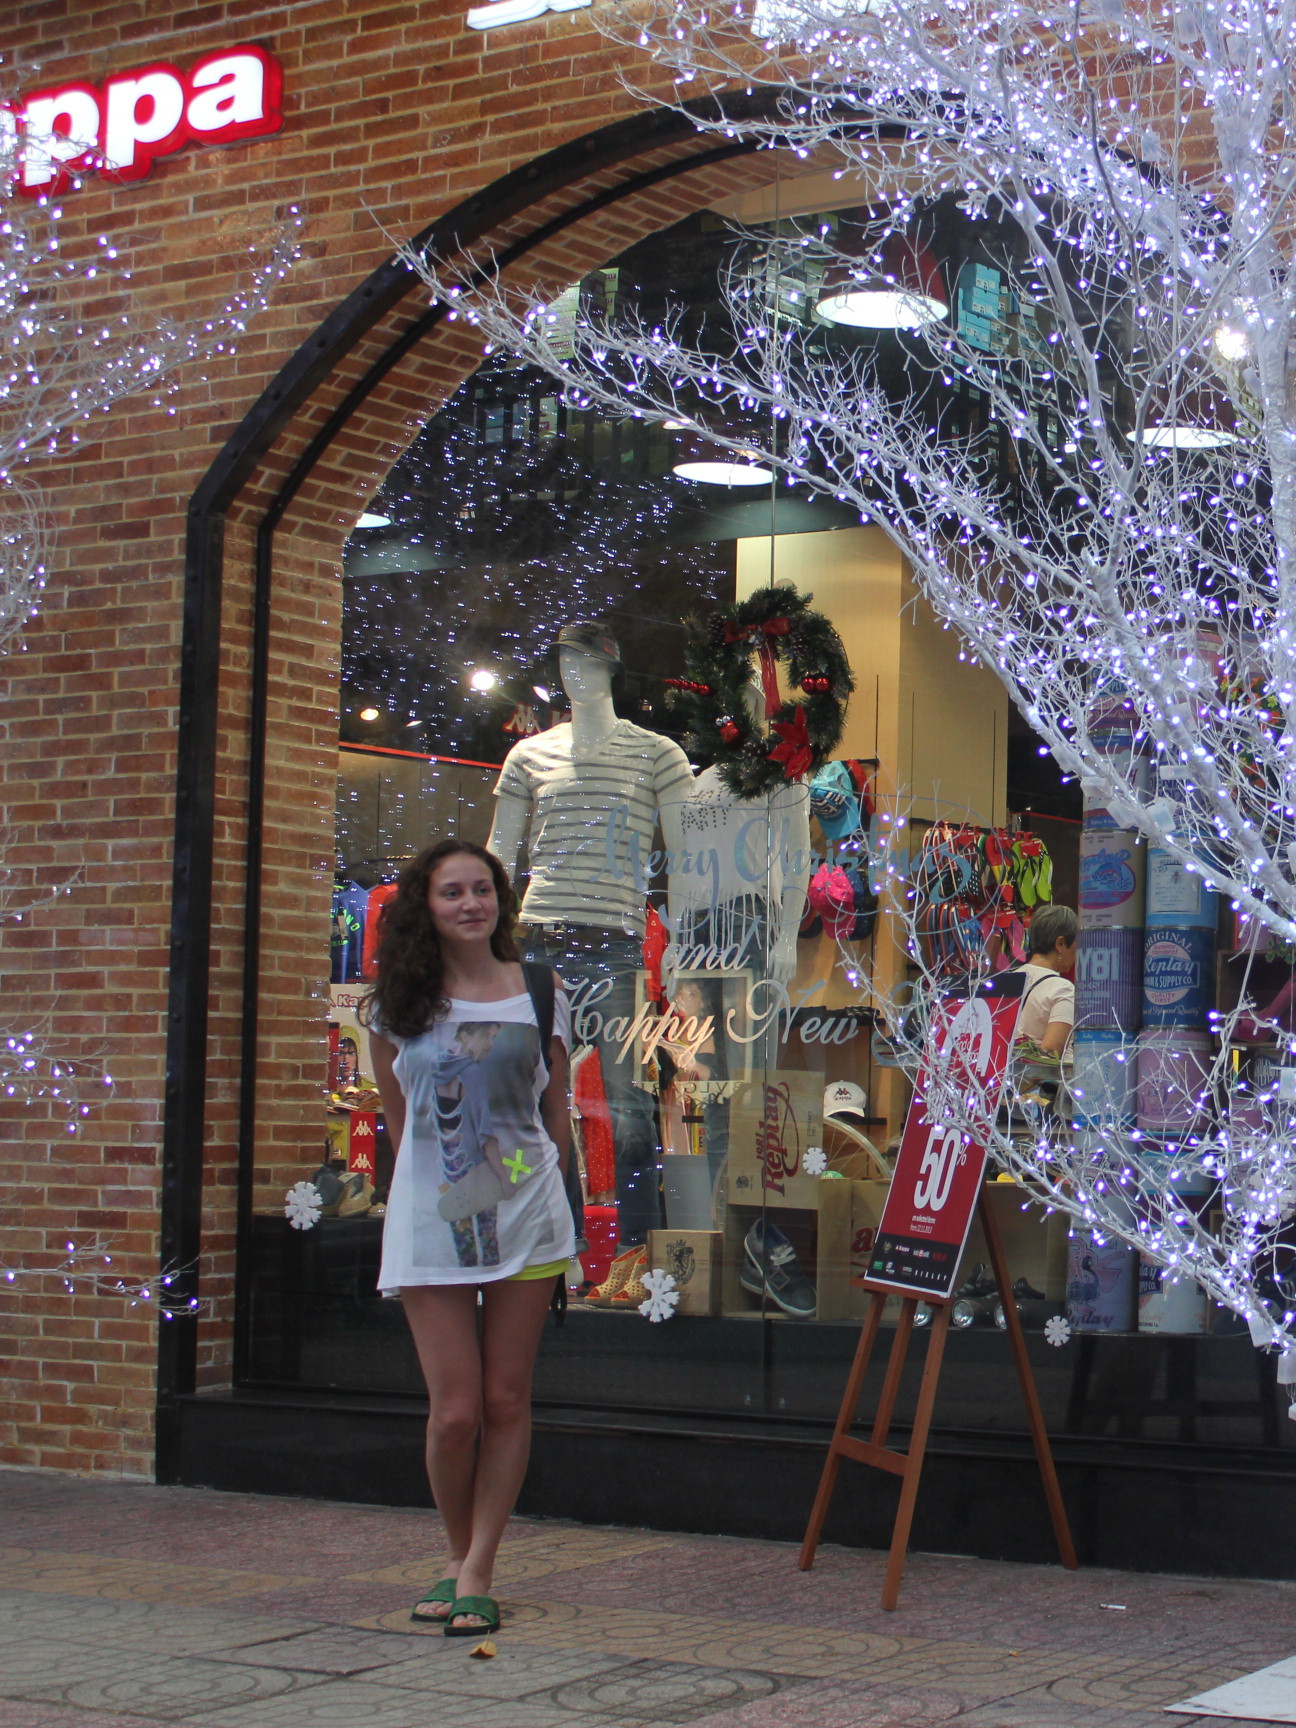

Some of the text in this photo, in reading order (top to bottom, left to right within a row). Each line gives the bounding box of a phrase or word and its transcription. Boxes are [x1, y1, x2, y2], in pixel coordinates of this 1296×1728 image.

[0, 55, 264, 187] ppa
[585, 804, 722, 932] Merry
[662, 915, 762, 971] and
[1144, 957, 1195, 975] Replay
[1145, 931, 1192, 953] ORIGINAL
[1160, 976, 1182, 987] SUPPLY
[563, 977, 716, 1067] Happy
[727, 978, 858, 1045] New
[762, 1081, 800, 1198] Replay
